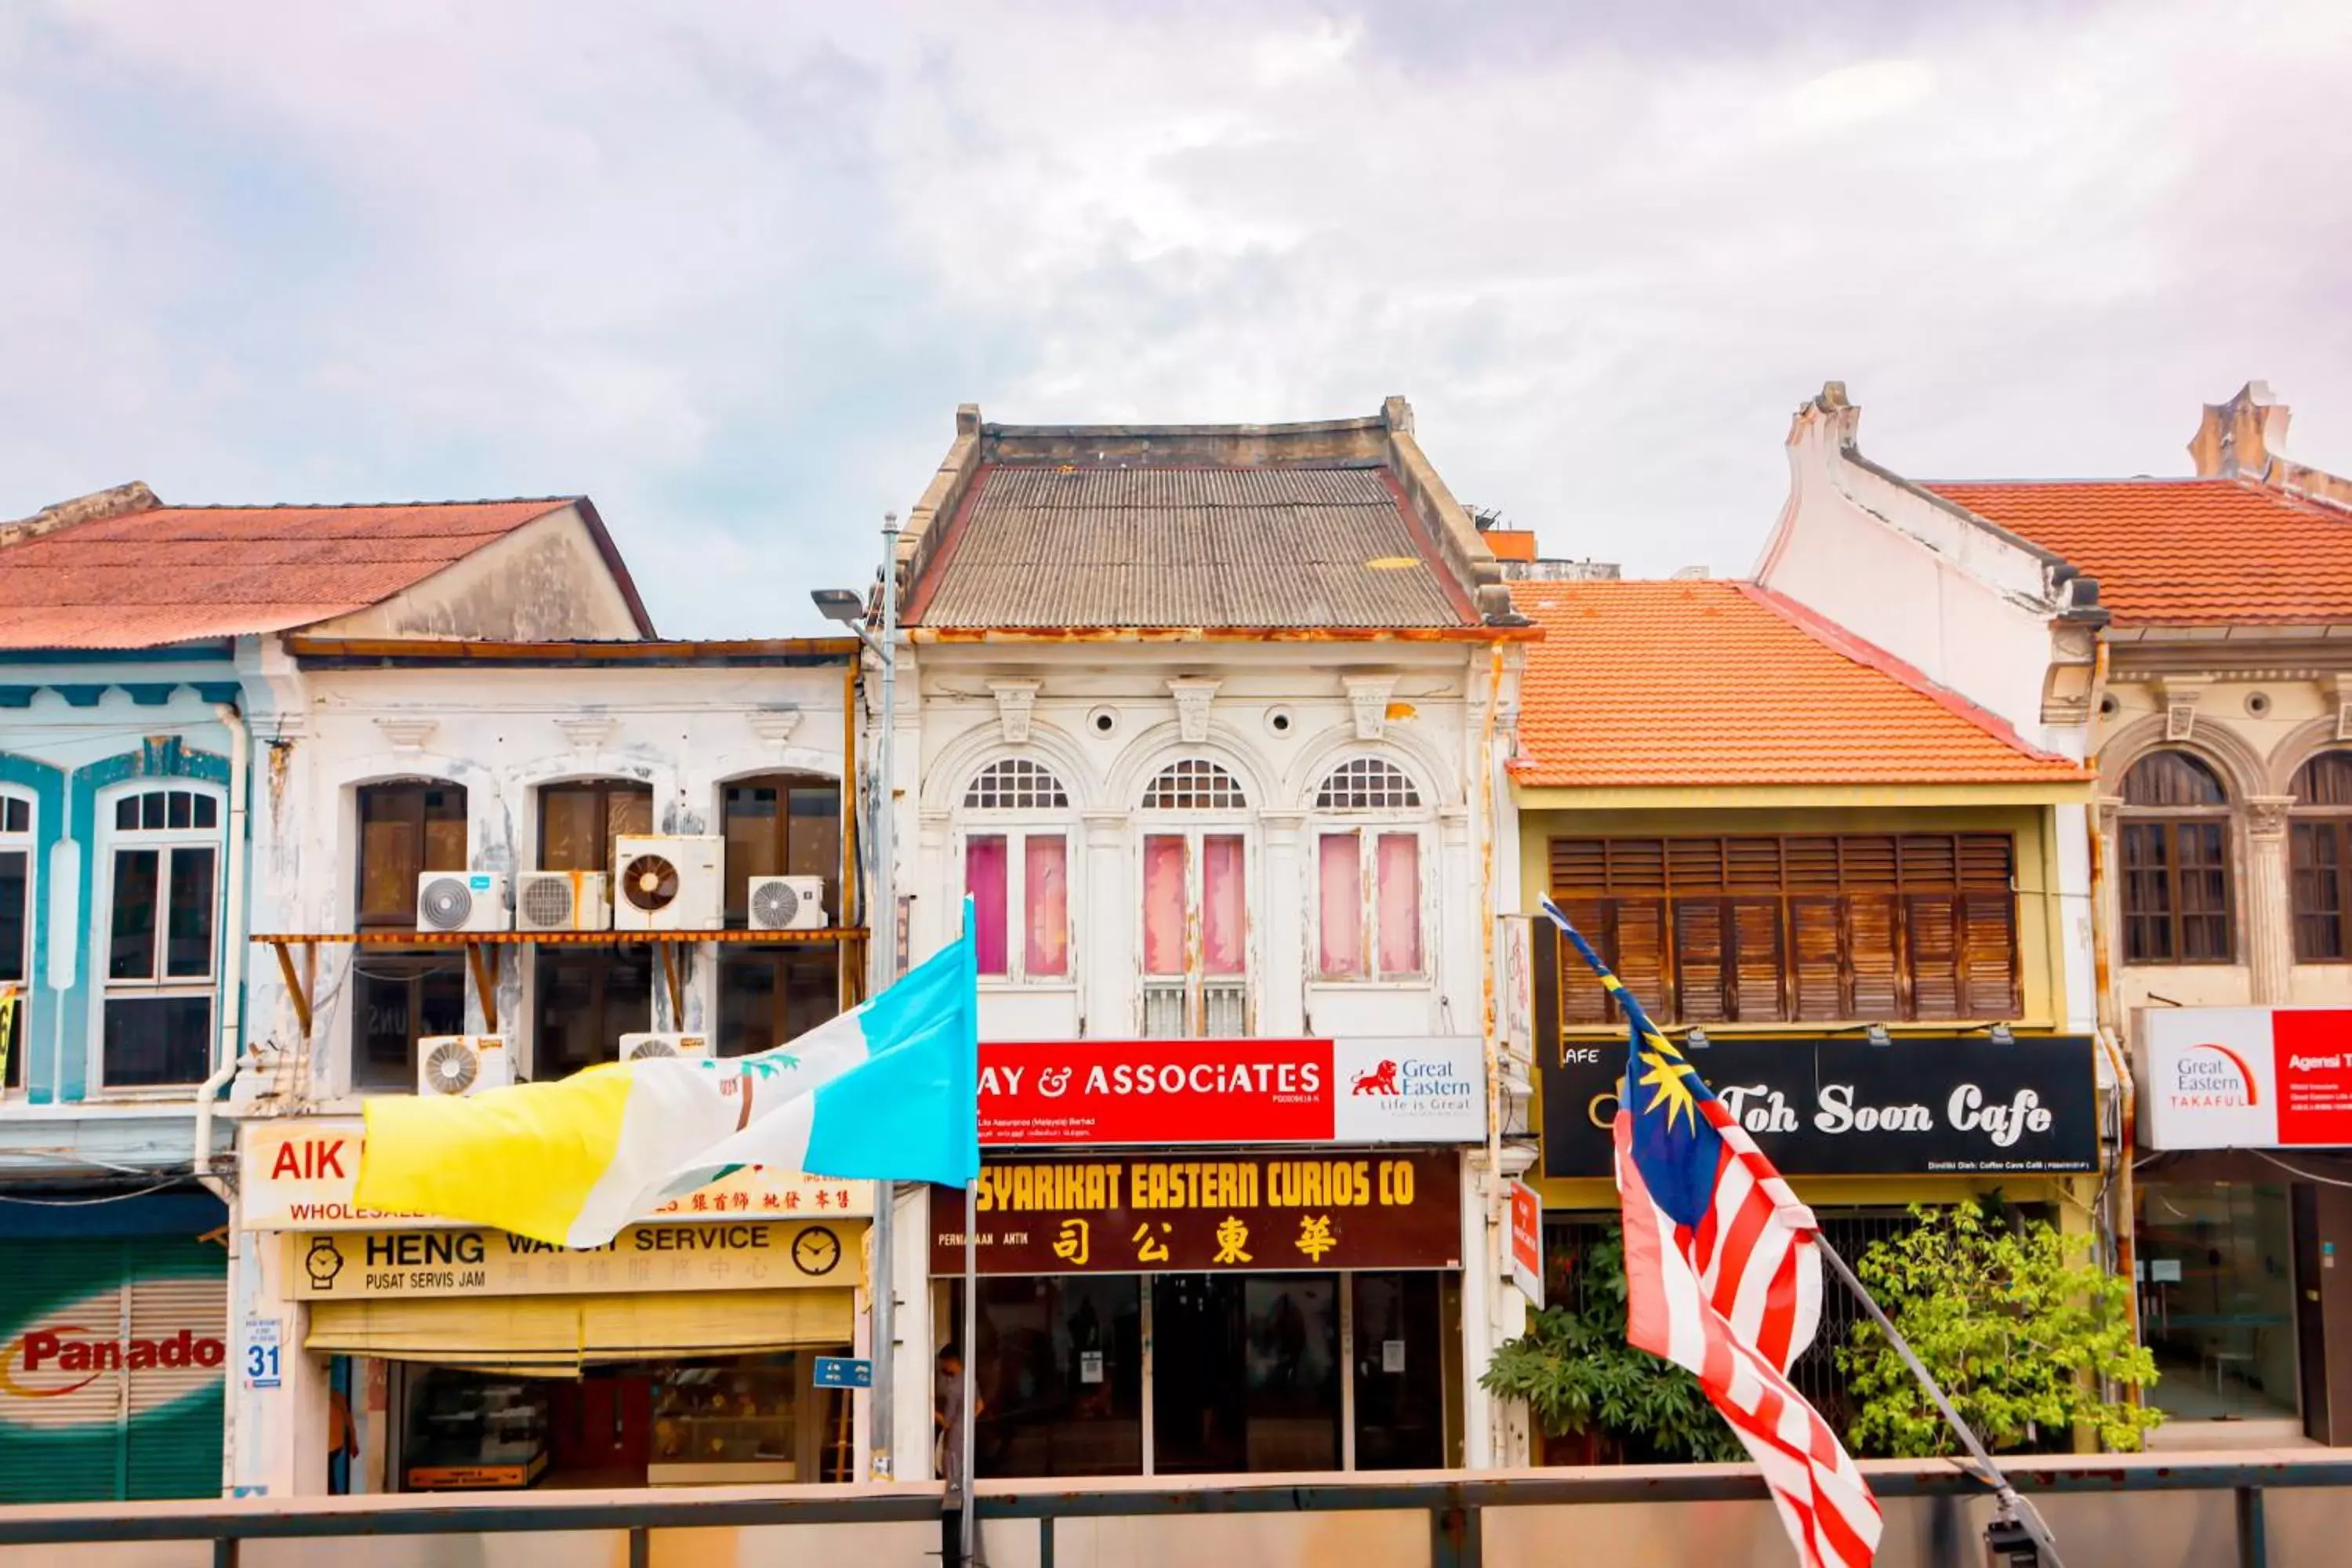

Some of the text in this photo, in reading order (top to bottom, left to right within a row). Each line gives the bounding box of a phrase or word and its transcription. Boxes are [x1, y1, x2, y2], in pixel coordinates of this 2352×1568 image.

[1563, 1049, 1601, 1064] AFE
[2177, 1058, 2223, 1074] Great
[2288, 1054, 2340, 1072] Agensi
[1403, 1058, 1453, 1077] Great
[1037, 1066, 1073, 1098] &
[1403, 1078, 1470, 1095] Eastern
[2178, 1075, 2238, 1091] Eastern
[1381, 1098, 1471, 1110] Life is Great
[2170, 1095, 2245, 1108] TAKAFUL
[1718, 1083, 2052, 1147] Toh Soon Cafe
[271, 1139, 345, 1179] AIK
[976, 1160, 1414, 1210] SYARIKAT EASTERN CURIOS CO
[635, 1226, 770, 1250] SERVICE
[366, 1233, 485, 1265] HENG
[366, 1270, 485, 1290] PUSAT SERVIS JAM
[248, 1345, 279, 1377] 31
